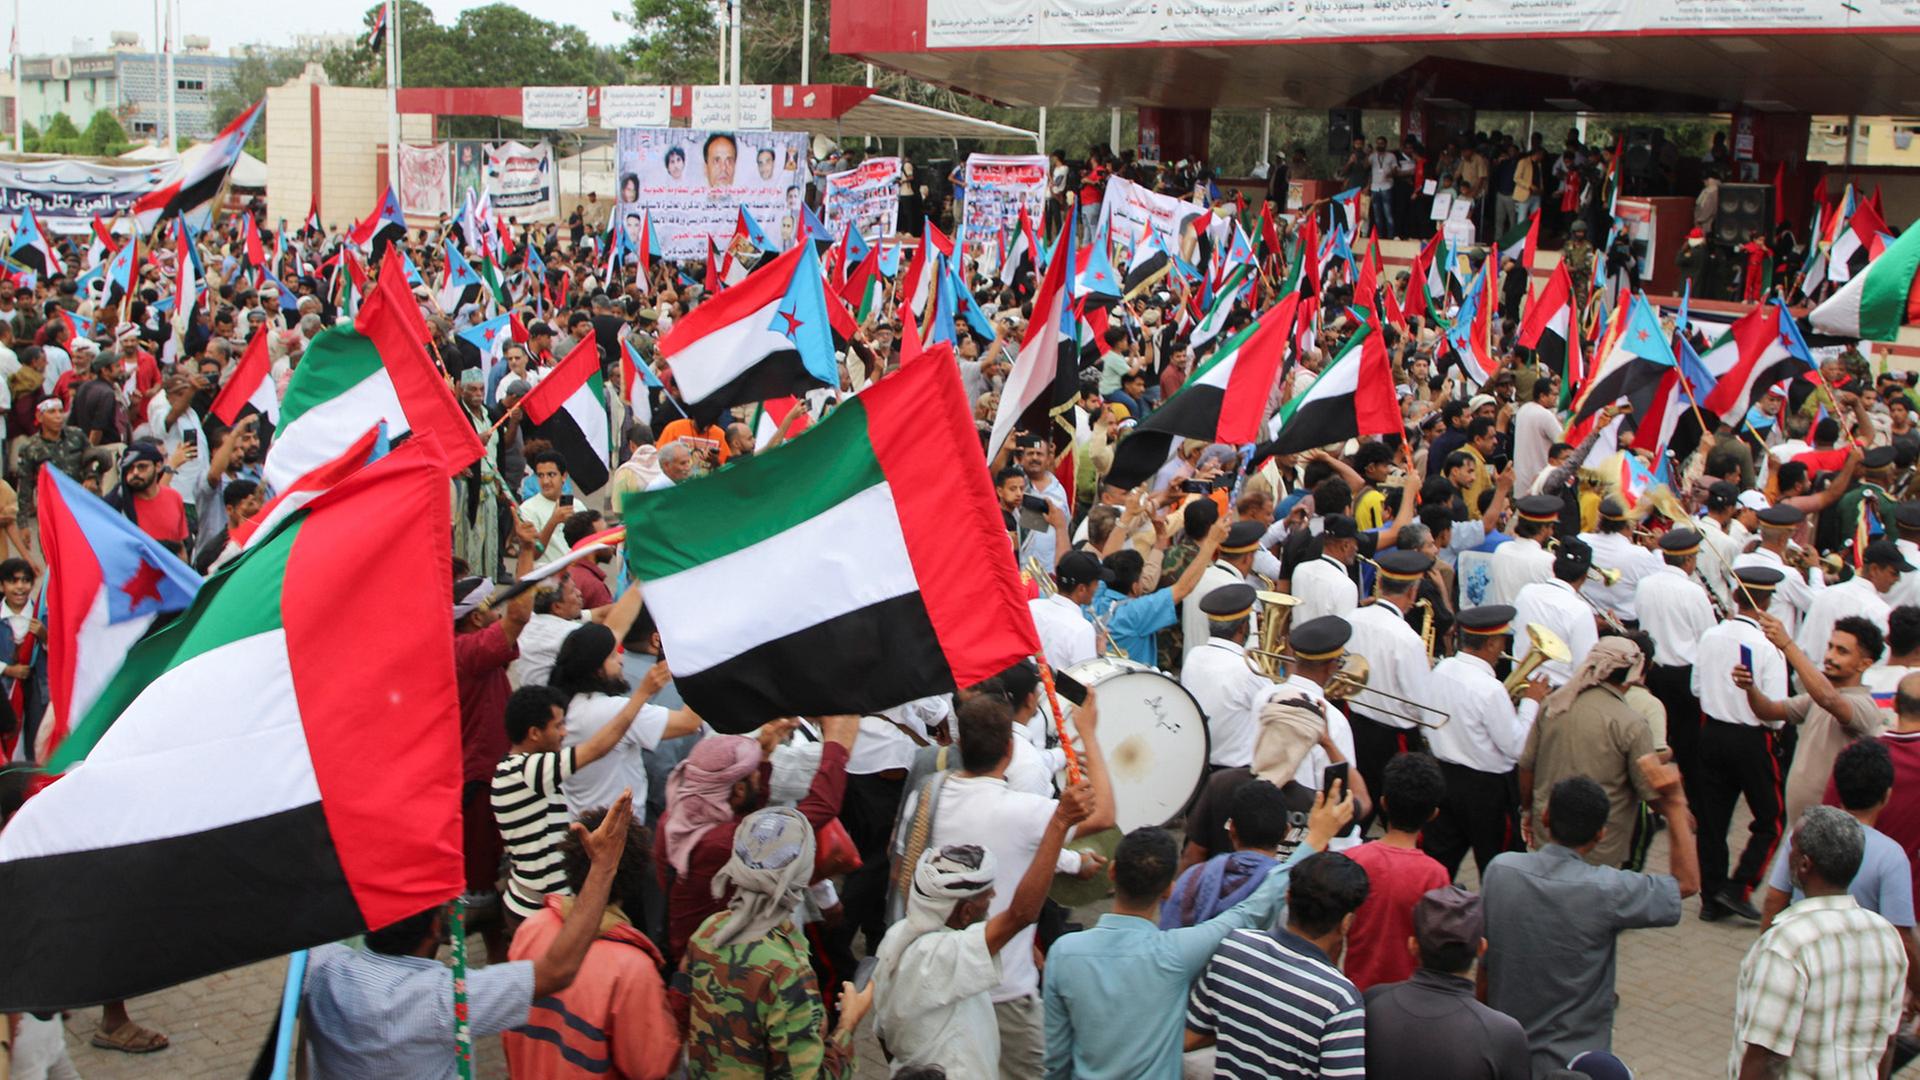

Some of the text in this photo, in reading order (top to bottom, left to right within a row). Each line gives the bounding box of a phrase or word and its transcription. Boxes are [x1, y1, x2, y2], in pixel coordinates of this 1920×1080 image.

[9, 191, 43, 212] وبكل
[45, 193, 73, 212] لكل
[73, 194, 111, 217] العربي
